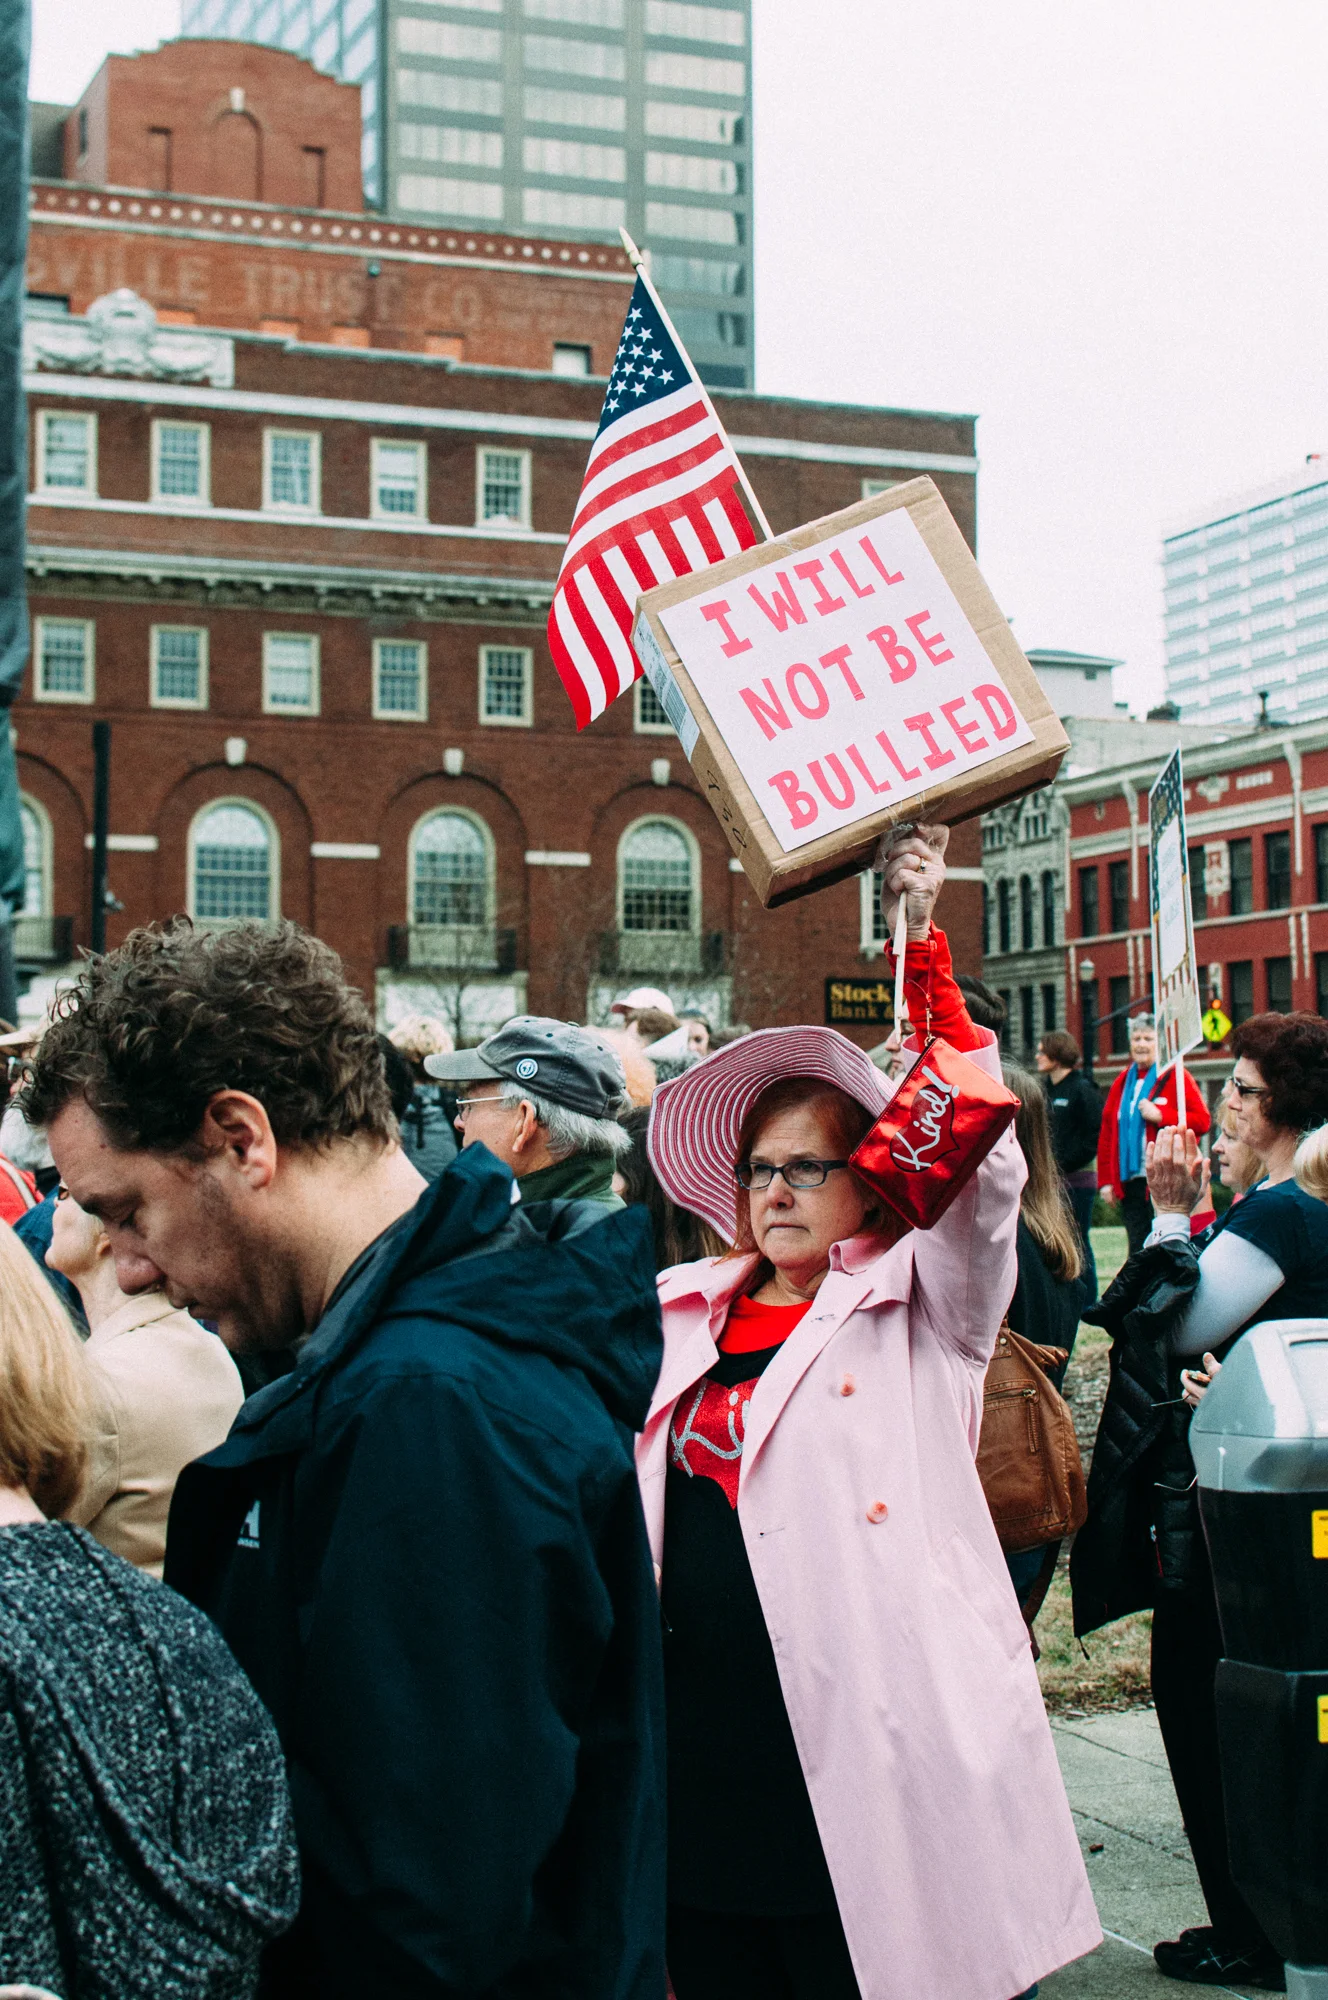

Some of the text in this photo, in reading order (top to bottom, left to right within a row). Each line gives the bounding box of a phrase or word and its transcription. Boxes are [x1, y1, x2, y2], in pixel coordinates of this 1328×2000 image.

[700, 536, 904, 658] I WILL
[739, 644, 865, 740] NOT
[867, 610, 954, 683] BE
[768, 684, 1018, 830] BULLIED
[831, 983, 891, 1003] Stock
[892, 1065, 960, 1170] Kind!
